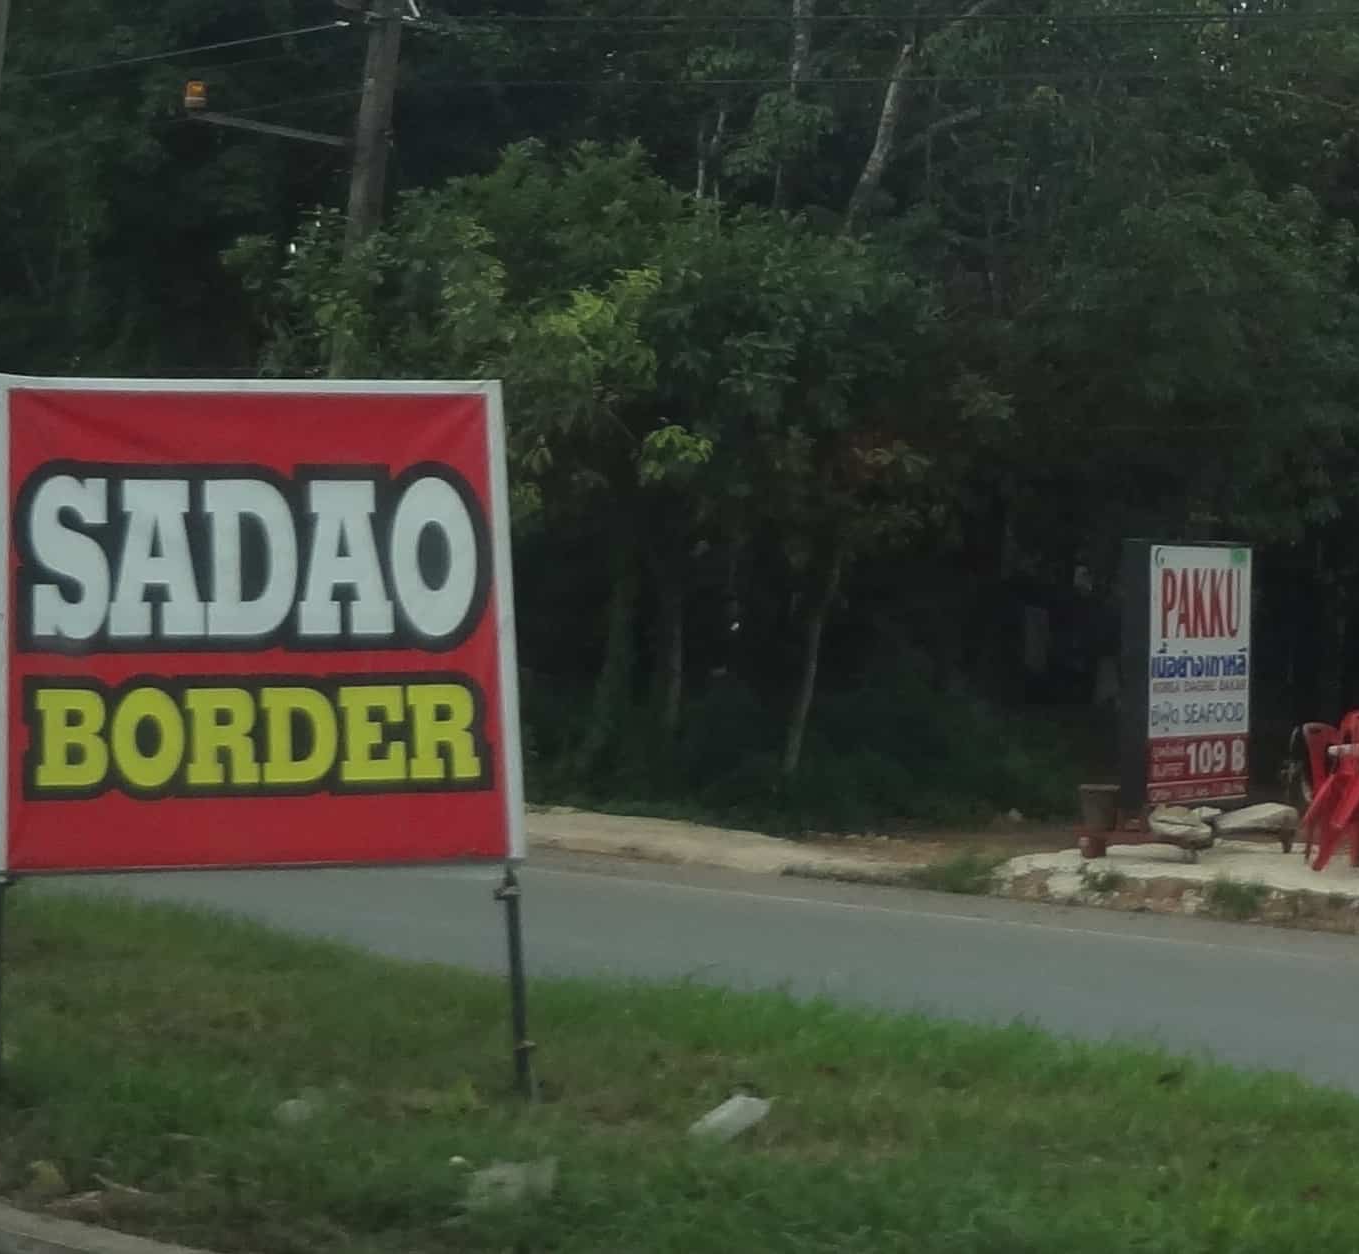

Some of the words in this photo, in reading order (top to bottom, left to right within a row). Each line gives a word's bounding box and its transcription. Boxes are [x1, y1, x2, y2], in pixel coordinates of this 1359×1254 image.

[29, 474, 478, 641] SADAO
[1160, 567, 1242, 639] PAKKU
[35, 683, 482, 788] BORDER
[1184, 701, 1246, 724] SEAFOOD
[1186, 740, 1227, 775] 109
